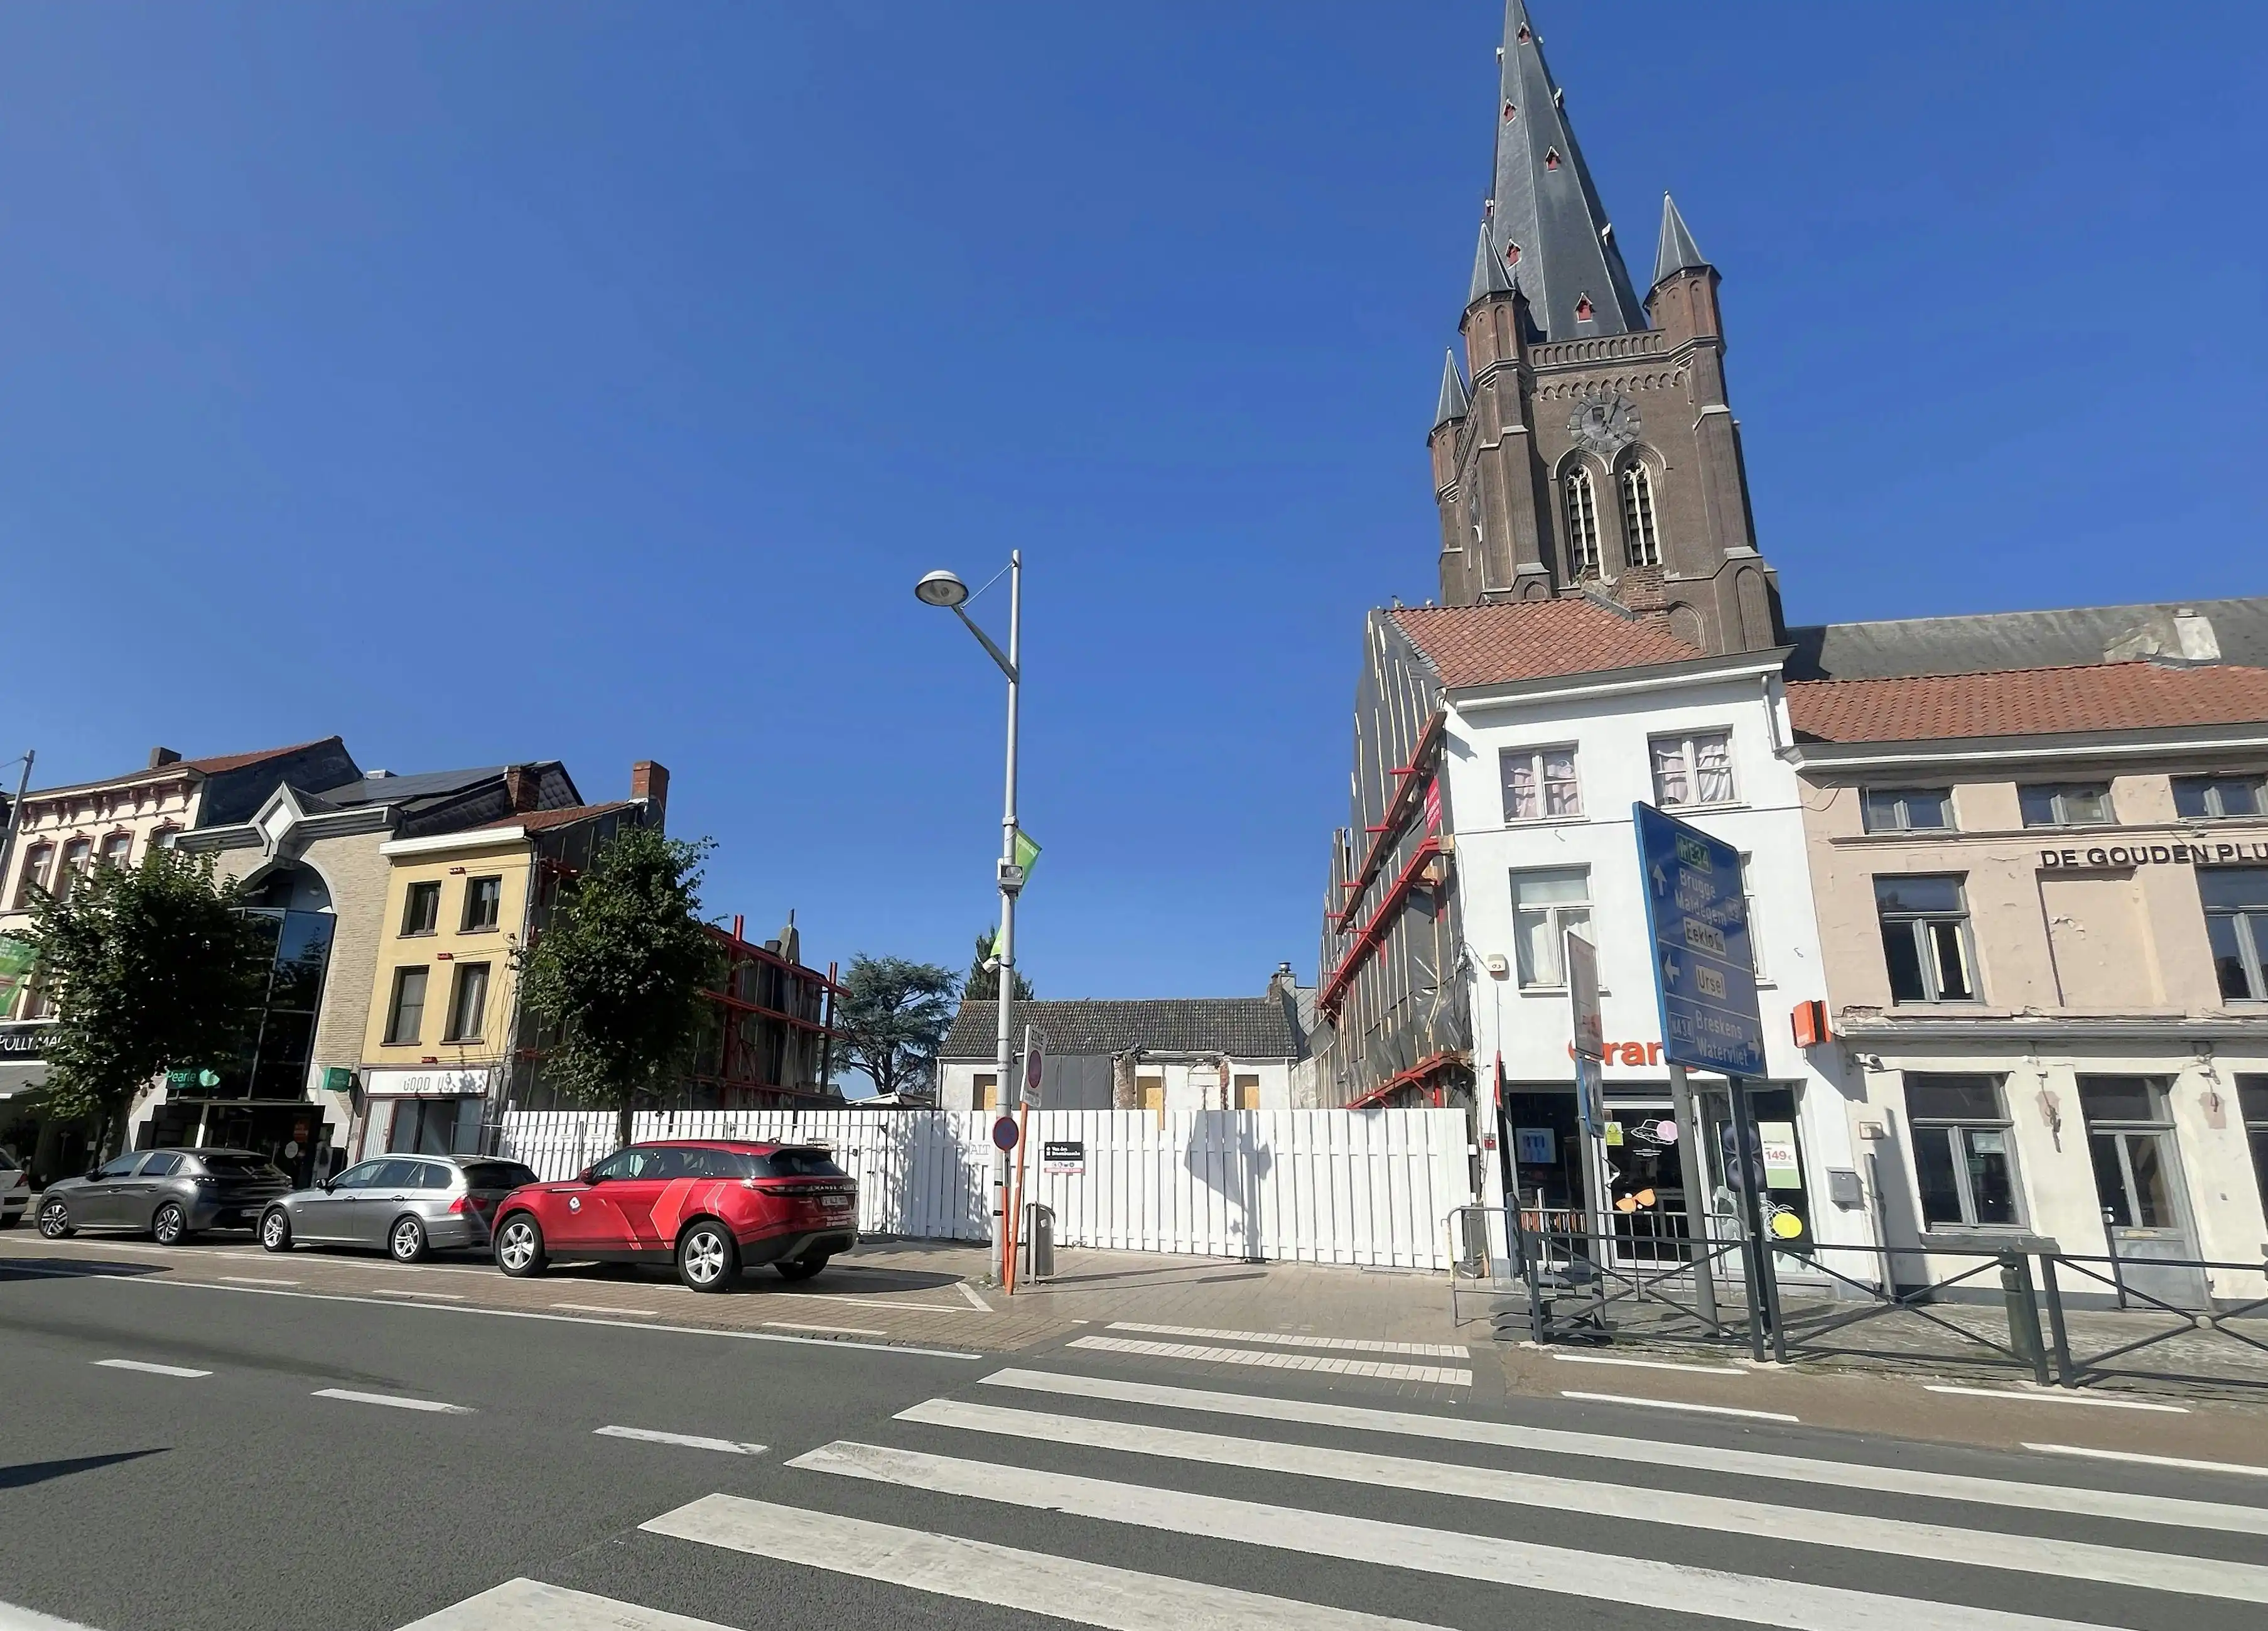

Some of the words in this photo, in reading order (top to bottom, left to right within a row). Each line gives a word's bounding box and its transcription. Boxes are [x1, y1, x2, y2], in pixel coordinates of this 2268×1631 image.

[2041, 850, 2079, 867] DE
[2087, 844, 2210, 865] GOUDEN
[1679, 867, 1716, 901] Brugge
[1675, 889, 1727, 926] Maldegem
[1697, 969, 1724, 995] Ursel
[1031, 1029, 1044, 1046] ZONE
[1695, 1009, 1743, 1040] Breskens
[1696, 1036, 1749, 1066] Watervliet
[166, 1070, 197, 1082] Pearle
[404, 1076, 431, 1092] GOOD
